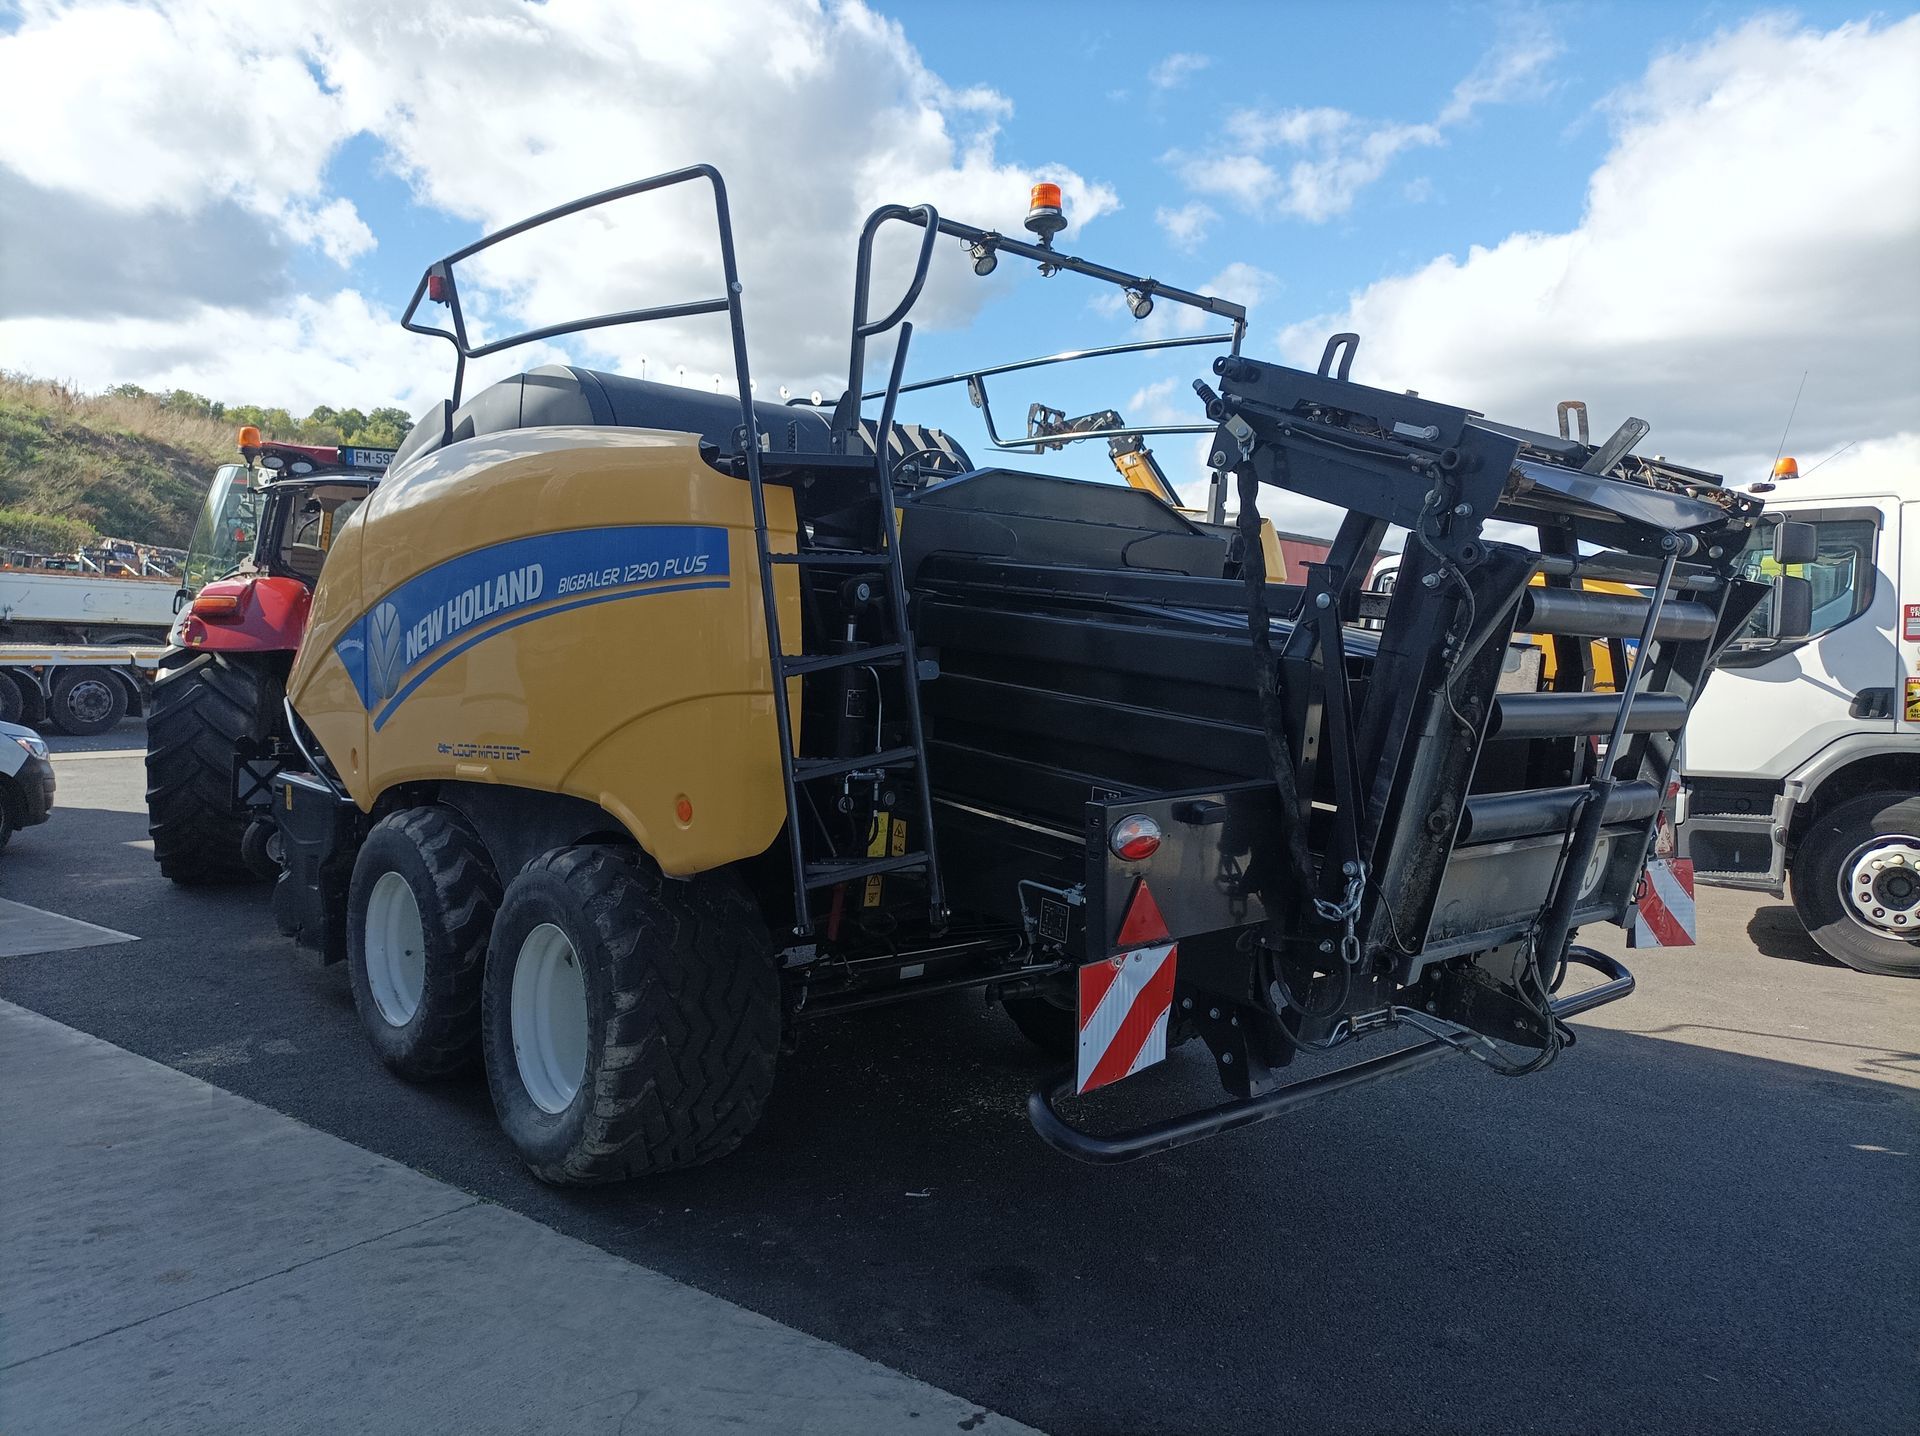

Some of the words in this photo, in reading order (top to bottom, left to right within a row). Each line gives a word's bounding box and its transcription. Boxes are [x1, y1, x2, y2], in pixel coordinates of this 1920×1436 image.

[558, 567, 620, 594] BIGBALER
[623, 561, 659, 582] 1290
[663, 554, 710, 576] PLUS
[406, 605, 444, 665] NEW
[447, 563, 544, 635] HOLLAND
